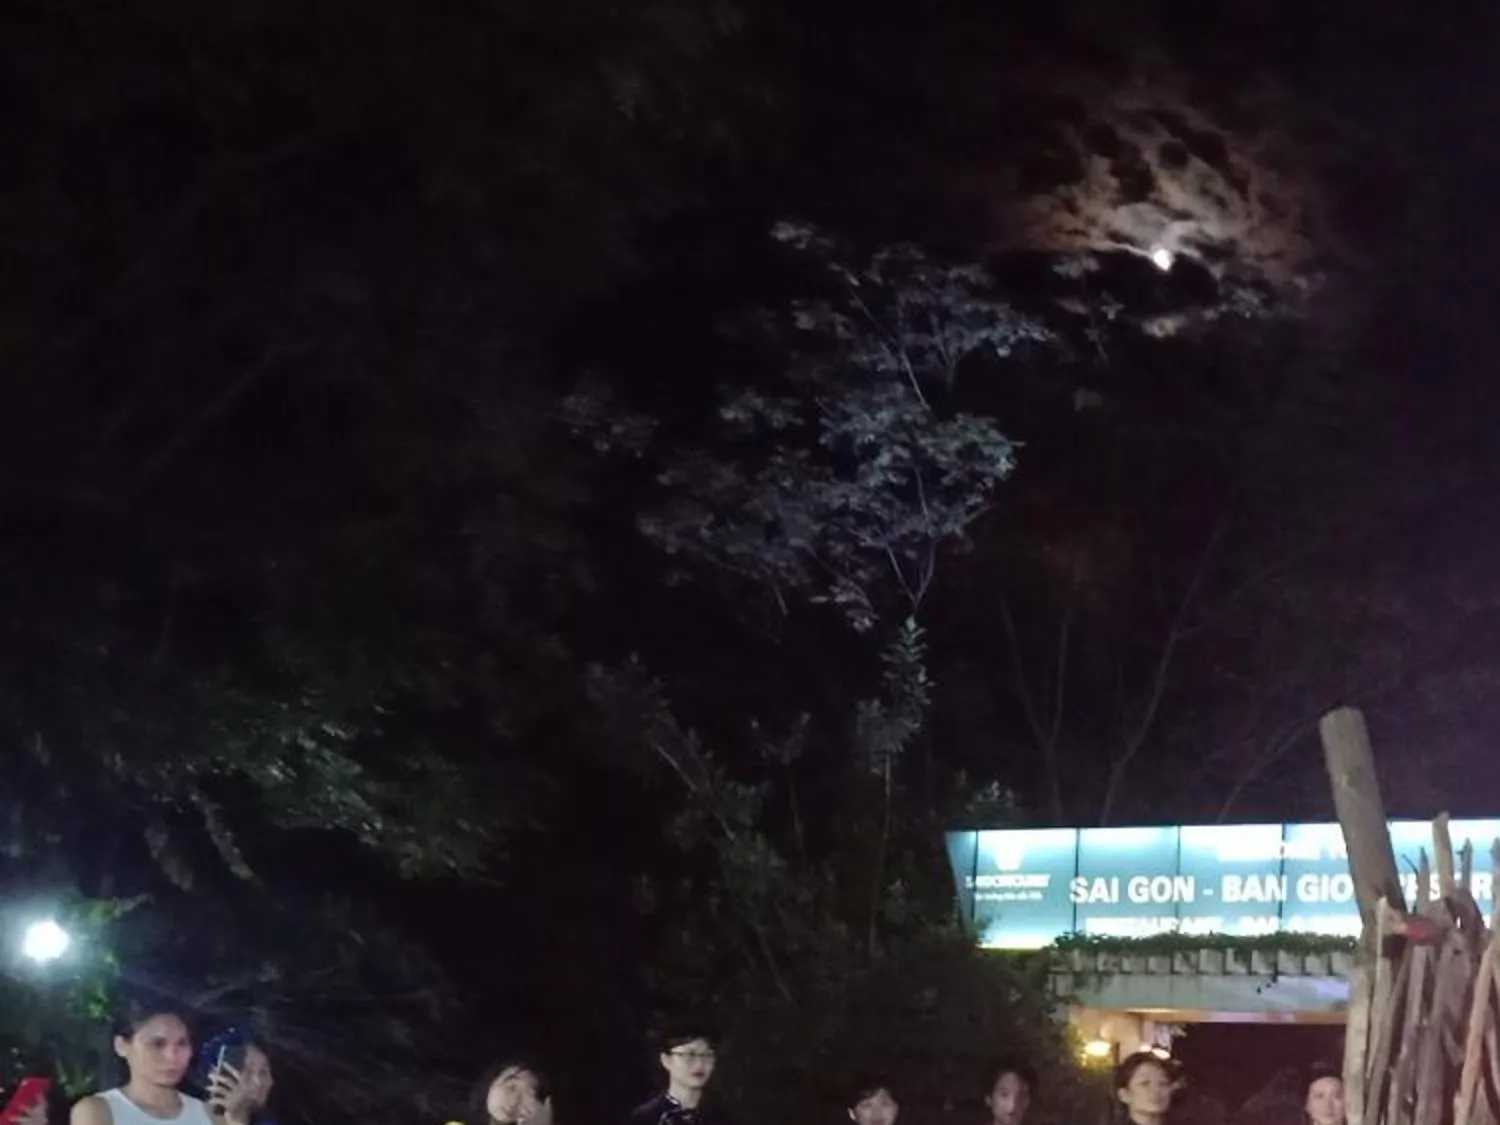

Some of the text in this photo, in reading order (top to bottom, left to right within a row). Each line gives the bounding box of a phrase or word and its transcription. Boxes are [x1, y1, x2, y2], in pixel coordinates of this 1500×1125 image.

[1069, 875, 1120, 904] SAI
[1127, 875, 1196, 903] GON
[1296, 873, 1355, 902] GIO
